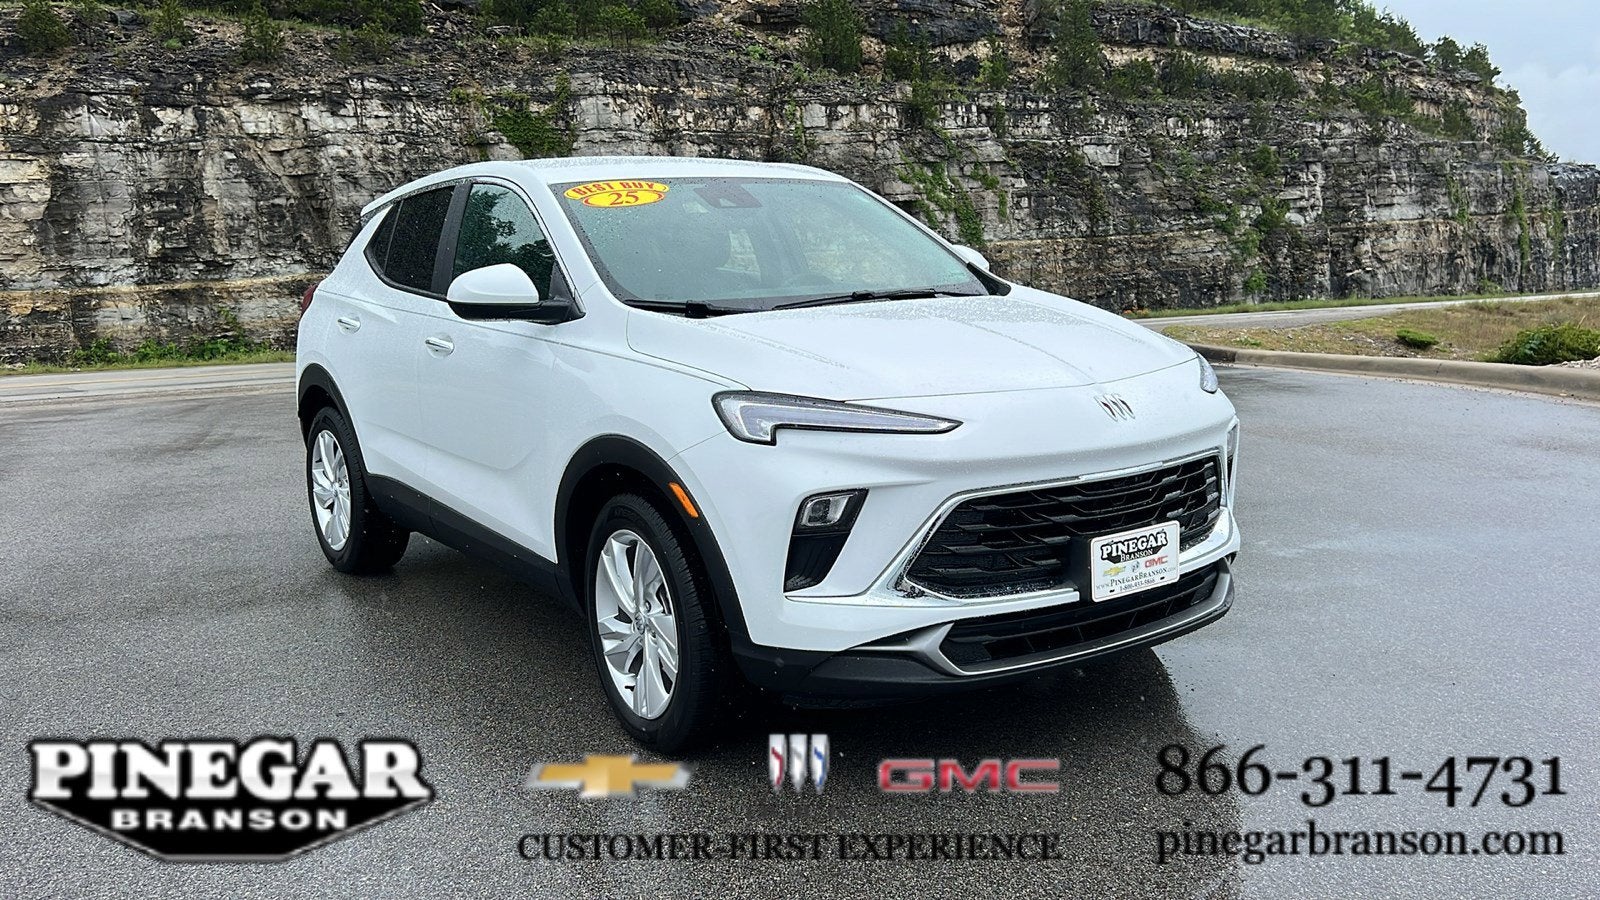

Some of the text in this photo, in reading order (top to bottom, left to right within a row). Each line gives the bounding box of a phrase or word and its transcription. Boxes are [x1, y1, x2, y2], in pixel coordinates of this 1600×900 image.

[572, 181, 655, 196] BEST BUY
[608, 190, 639, 206] 25
[1101, 531, 1168, 560] PINEGAR
[1145, 555, 1168, 568] GMC
